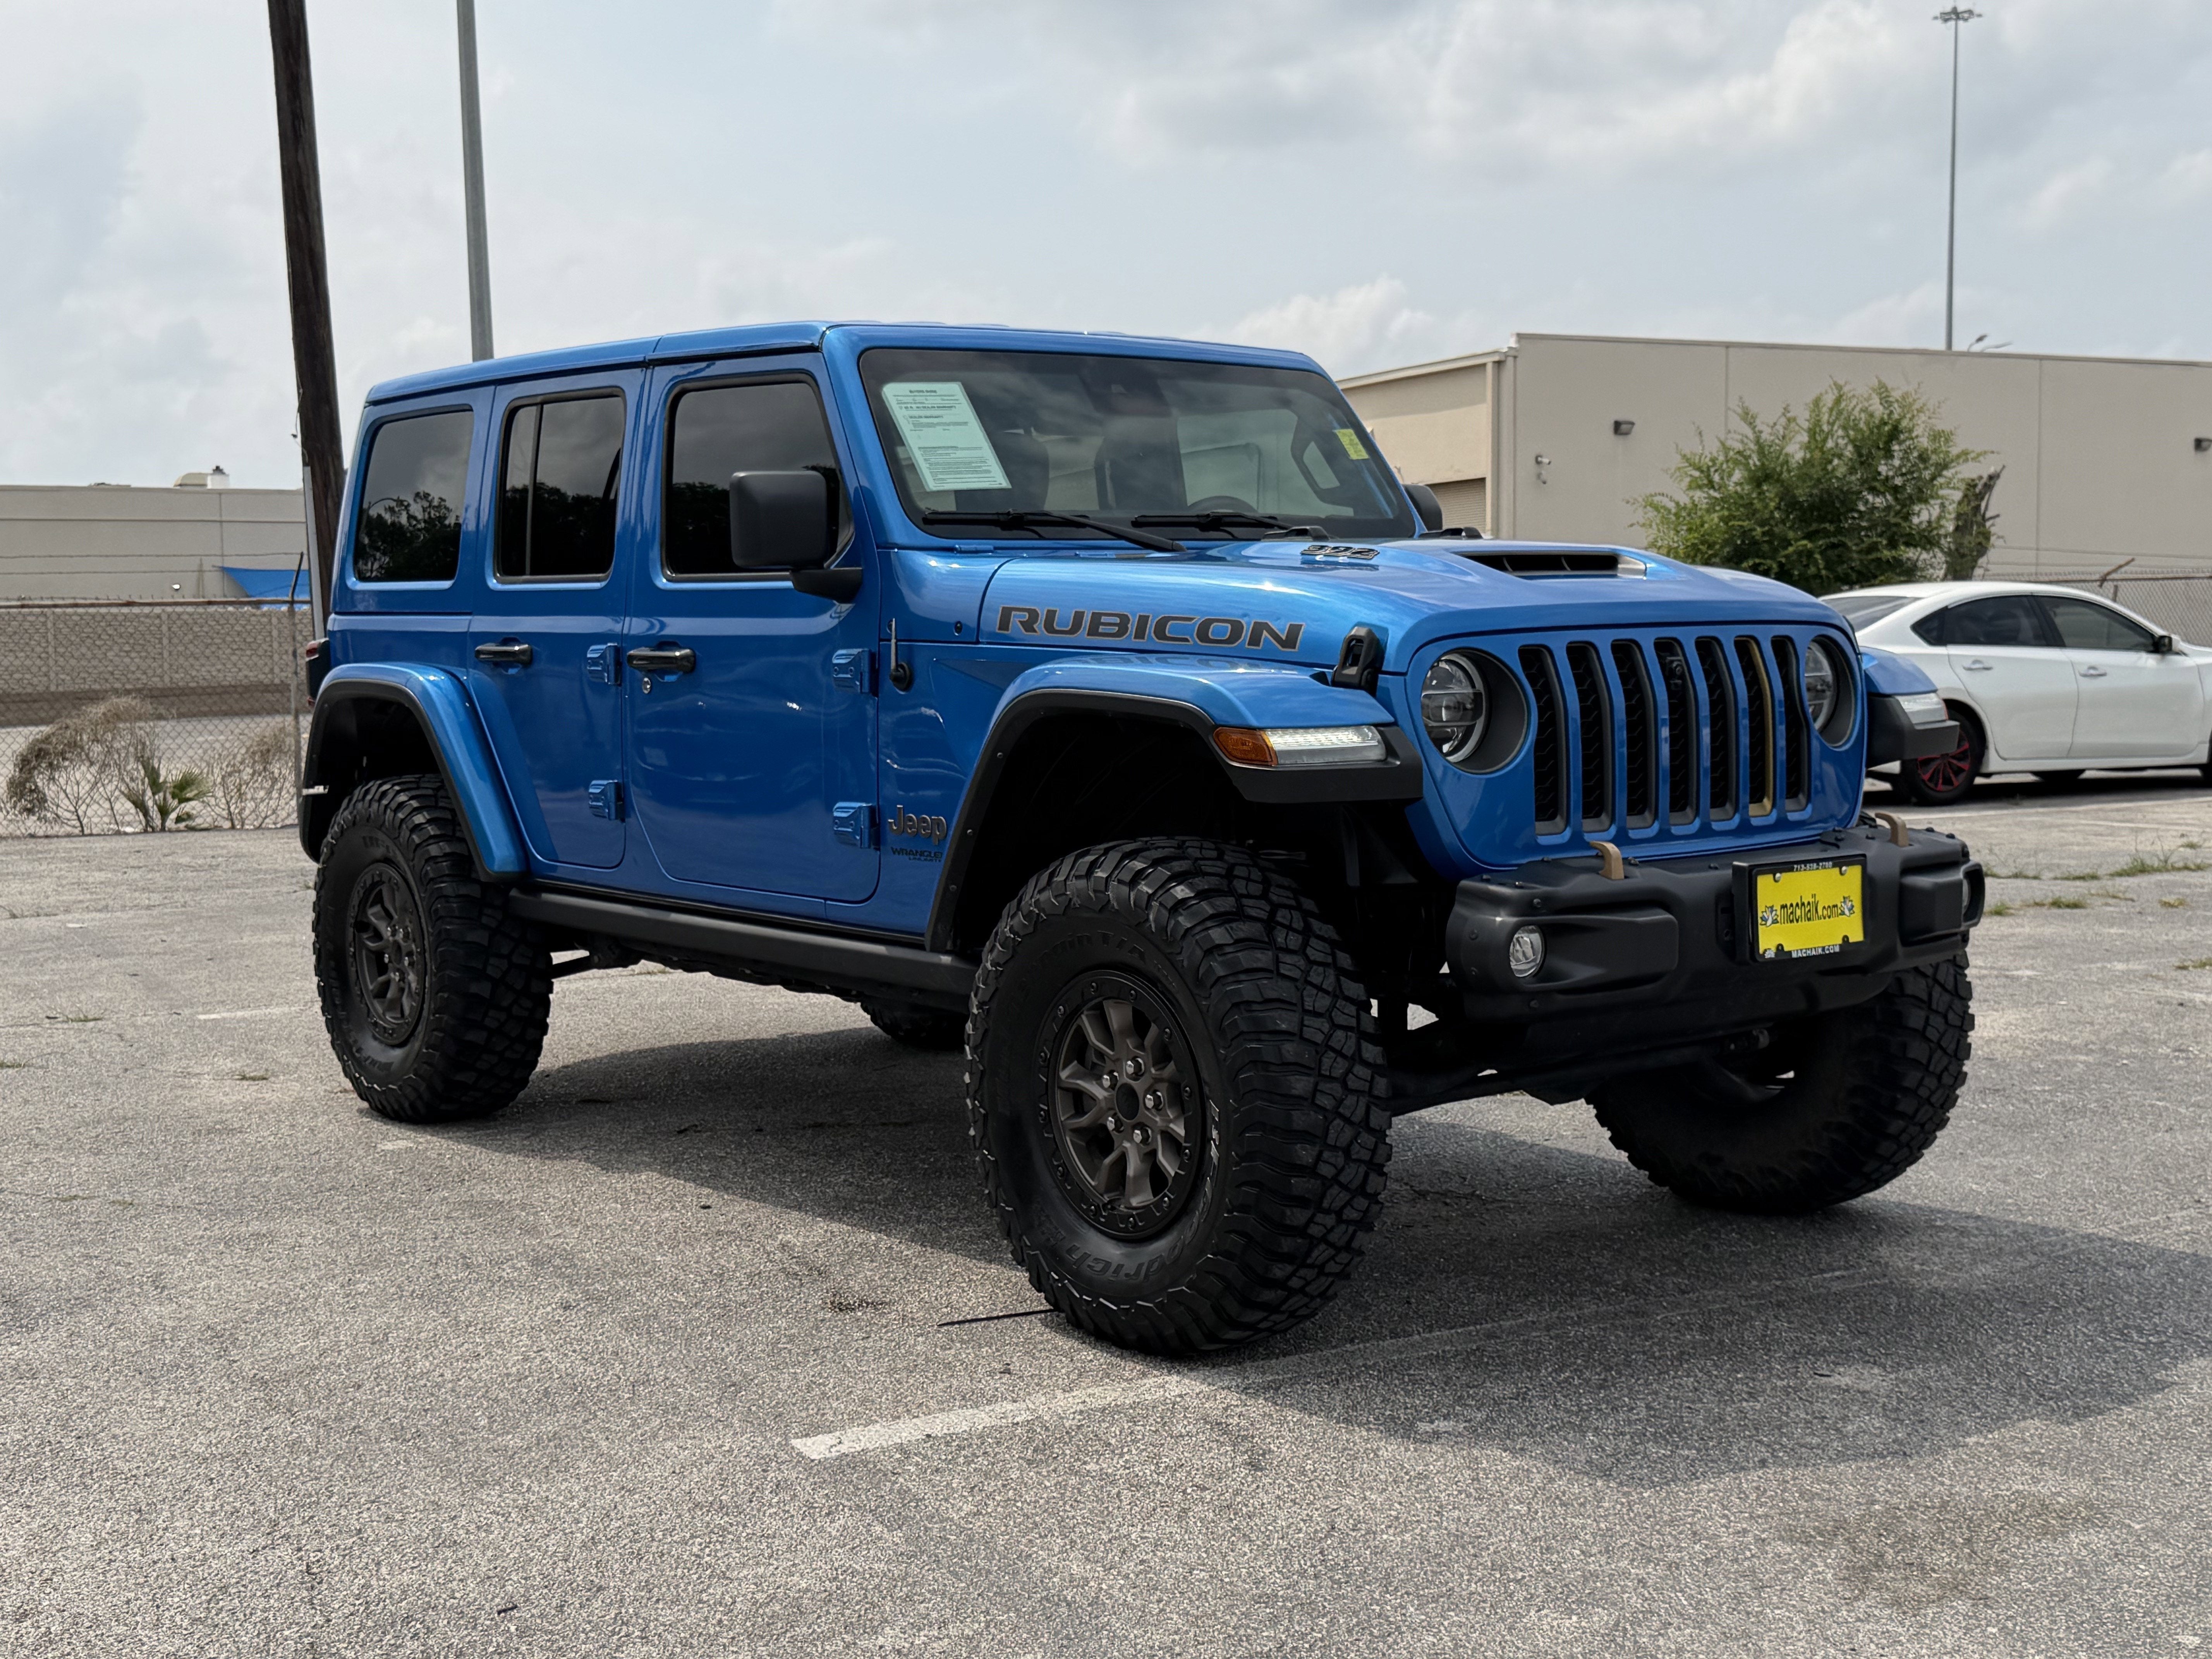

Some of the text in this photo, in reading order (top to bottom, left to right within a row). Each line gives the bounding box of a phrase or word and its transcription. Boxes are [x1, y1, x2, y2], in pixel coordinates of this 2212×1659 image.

[1300, 545, 1380, 559] 392
[997, 605, 1305, 652] RUBICON
[888, 804, 947, 845] Jeep
[1779, 893, 1839, 925] machaik.com
[1791, 945, 1840, 958] MACHAIK.COM
